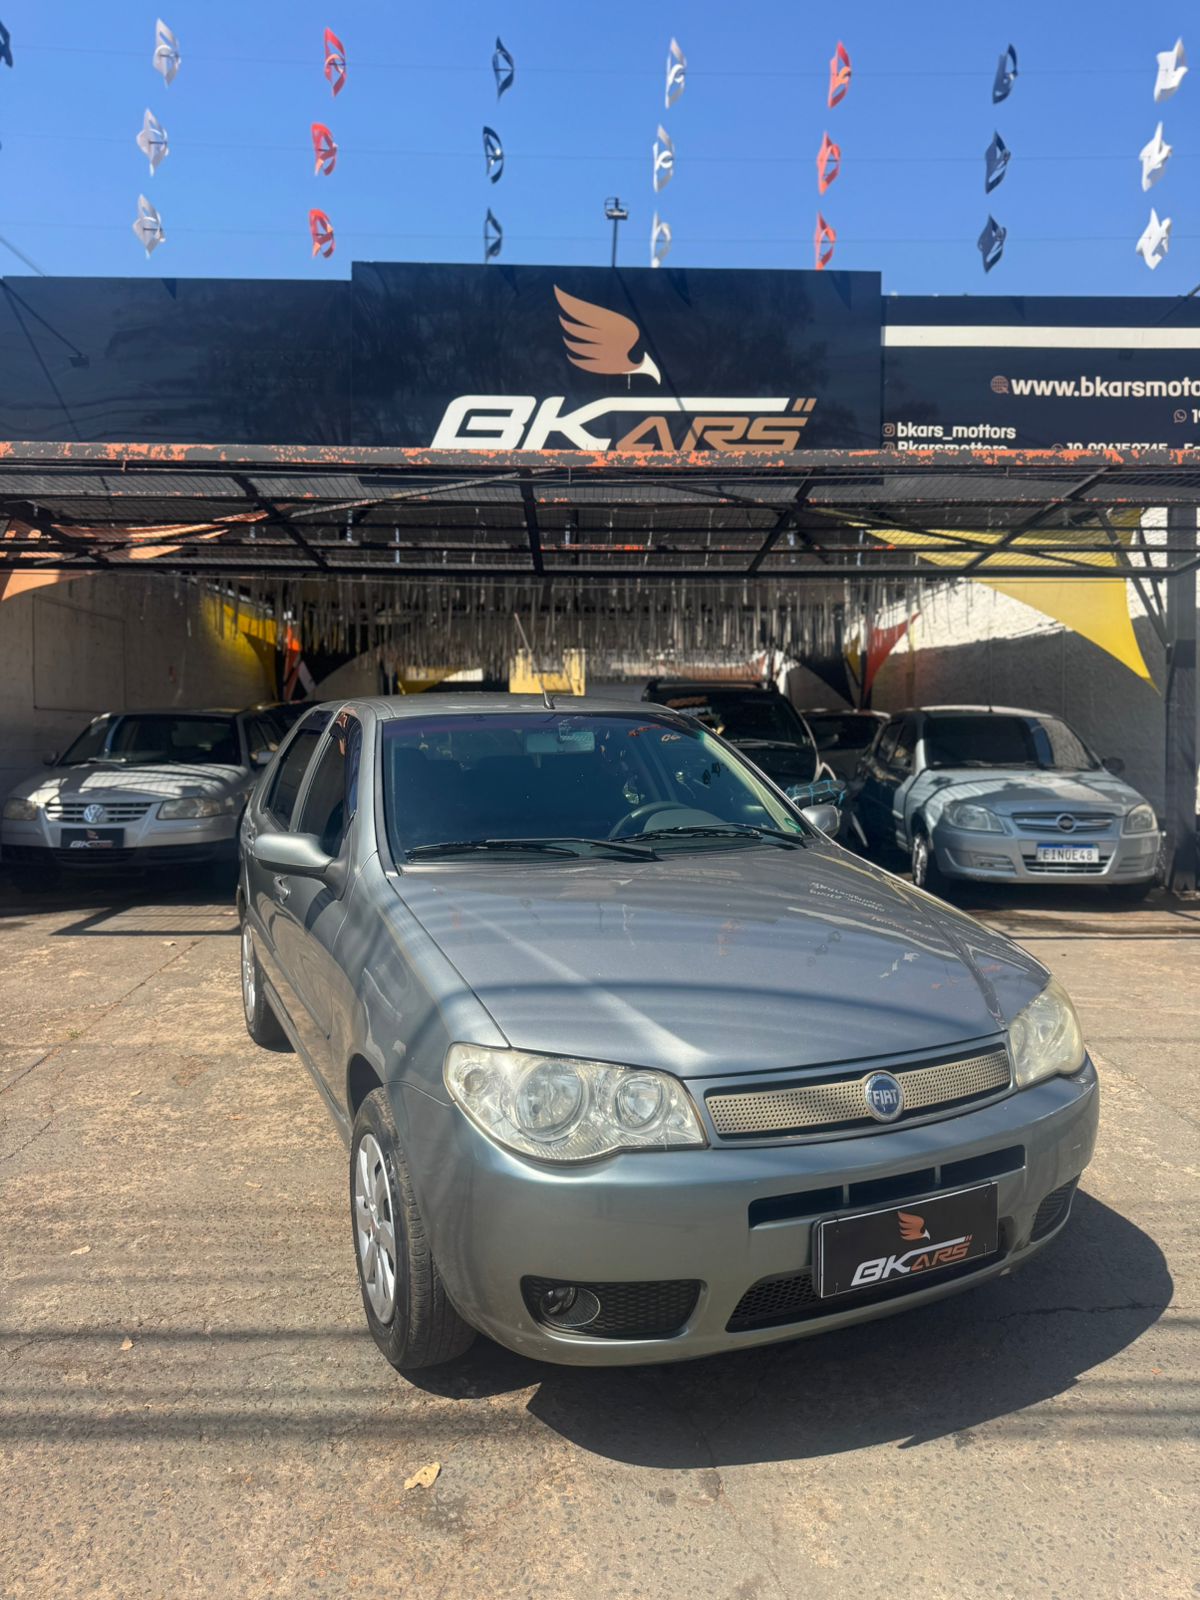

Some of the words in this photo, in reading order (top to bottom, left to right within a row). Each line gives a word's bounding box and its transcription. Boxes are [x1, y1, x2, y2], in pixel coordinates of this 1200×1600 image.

[430, 395, 810, 450] BKARS
[1191, 408, 1200, 423] 1
[897, 422, 1016, 440] bkars_mottors
[872, 1089, 897, 1105] FIAT
[850, 1235, 970, 1287] BKARS
